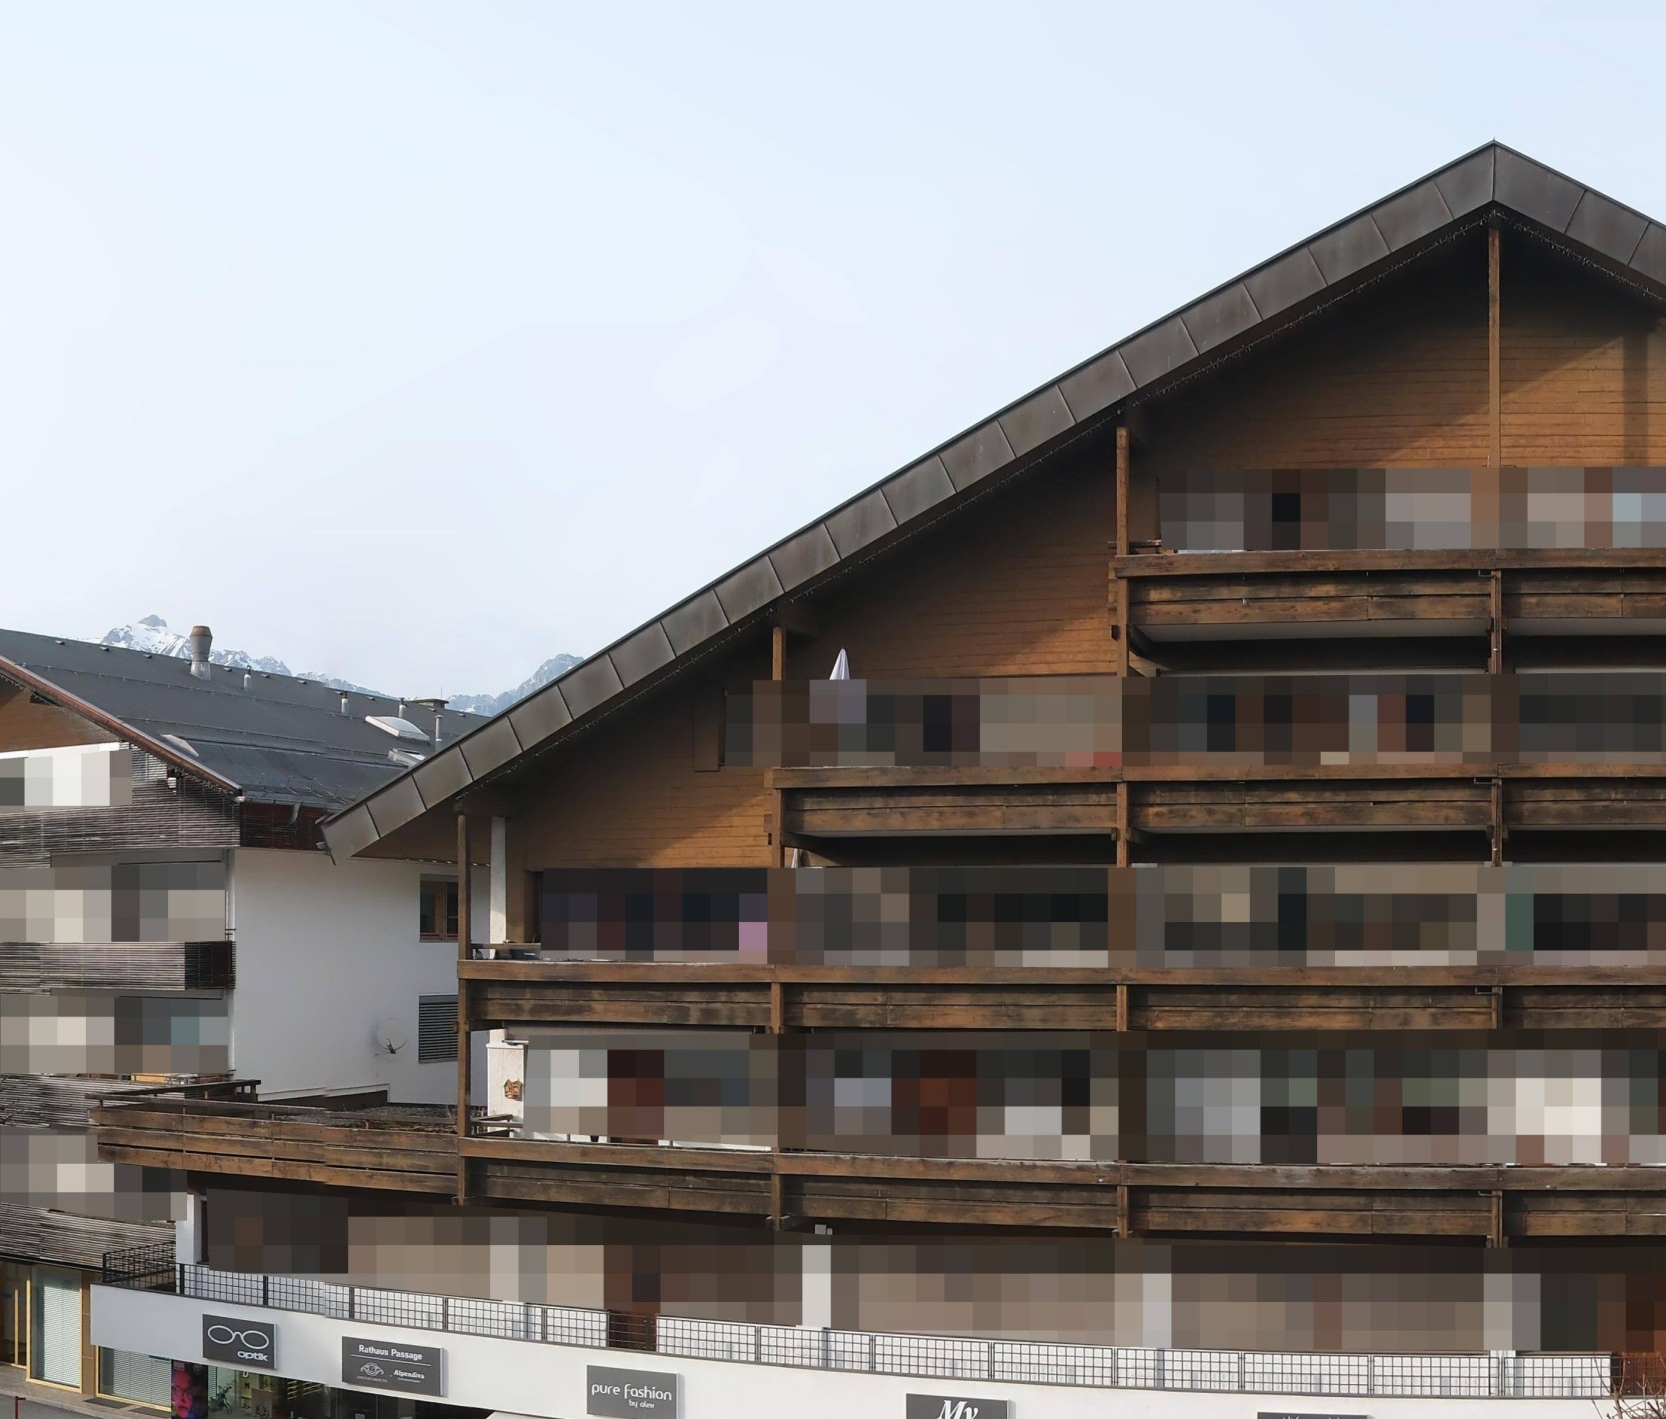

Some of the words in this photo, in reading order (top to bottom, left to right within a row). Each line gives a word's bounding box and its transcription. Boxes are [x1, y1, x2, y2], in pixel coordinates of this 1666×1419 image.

[237, 1351, 268, 1361] optik
[358, 1344, 388, 1355] Rathaus
[391, 1348, 422, 1361] Passage
[394, 1369, 425, 1379] Alpendiva
[591, 1384, 621, 1396] pure
[624, 1383, 672, 1401] fashion
[628, 1399, 638, 1408] by
